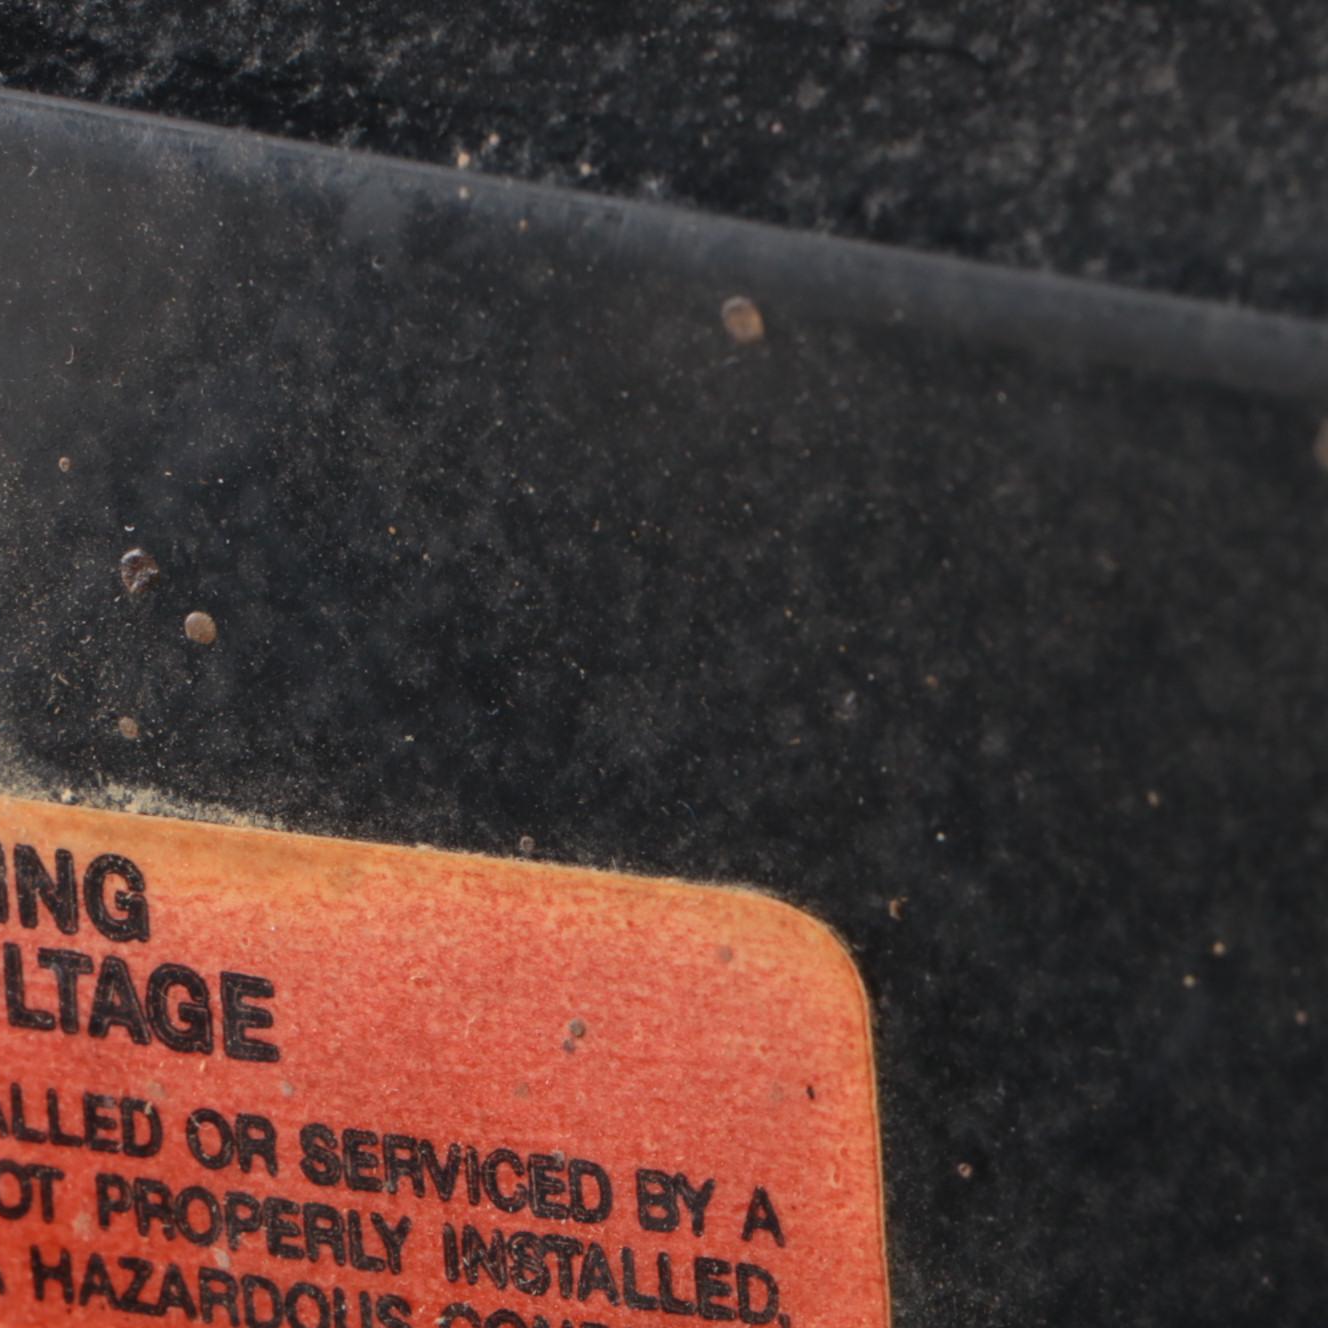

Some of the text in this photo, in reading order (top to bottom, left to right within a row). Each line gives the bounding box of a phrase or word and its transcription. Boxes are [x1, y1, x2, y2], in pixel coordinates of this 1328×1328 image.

[95, 1171, 411, 1276] PROPERLY
[184, 1106, 278, 1175] OR
[299, 1121, 614, 1223] SERVICED
[634, 1167, 716, 1237] BY
[740, 1185, 786, 1248] A
